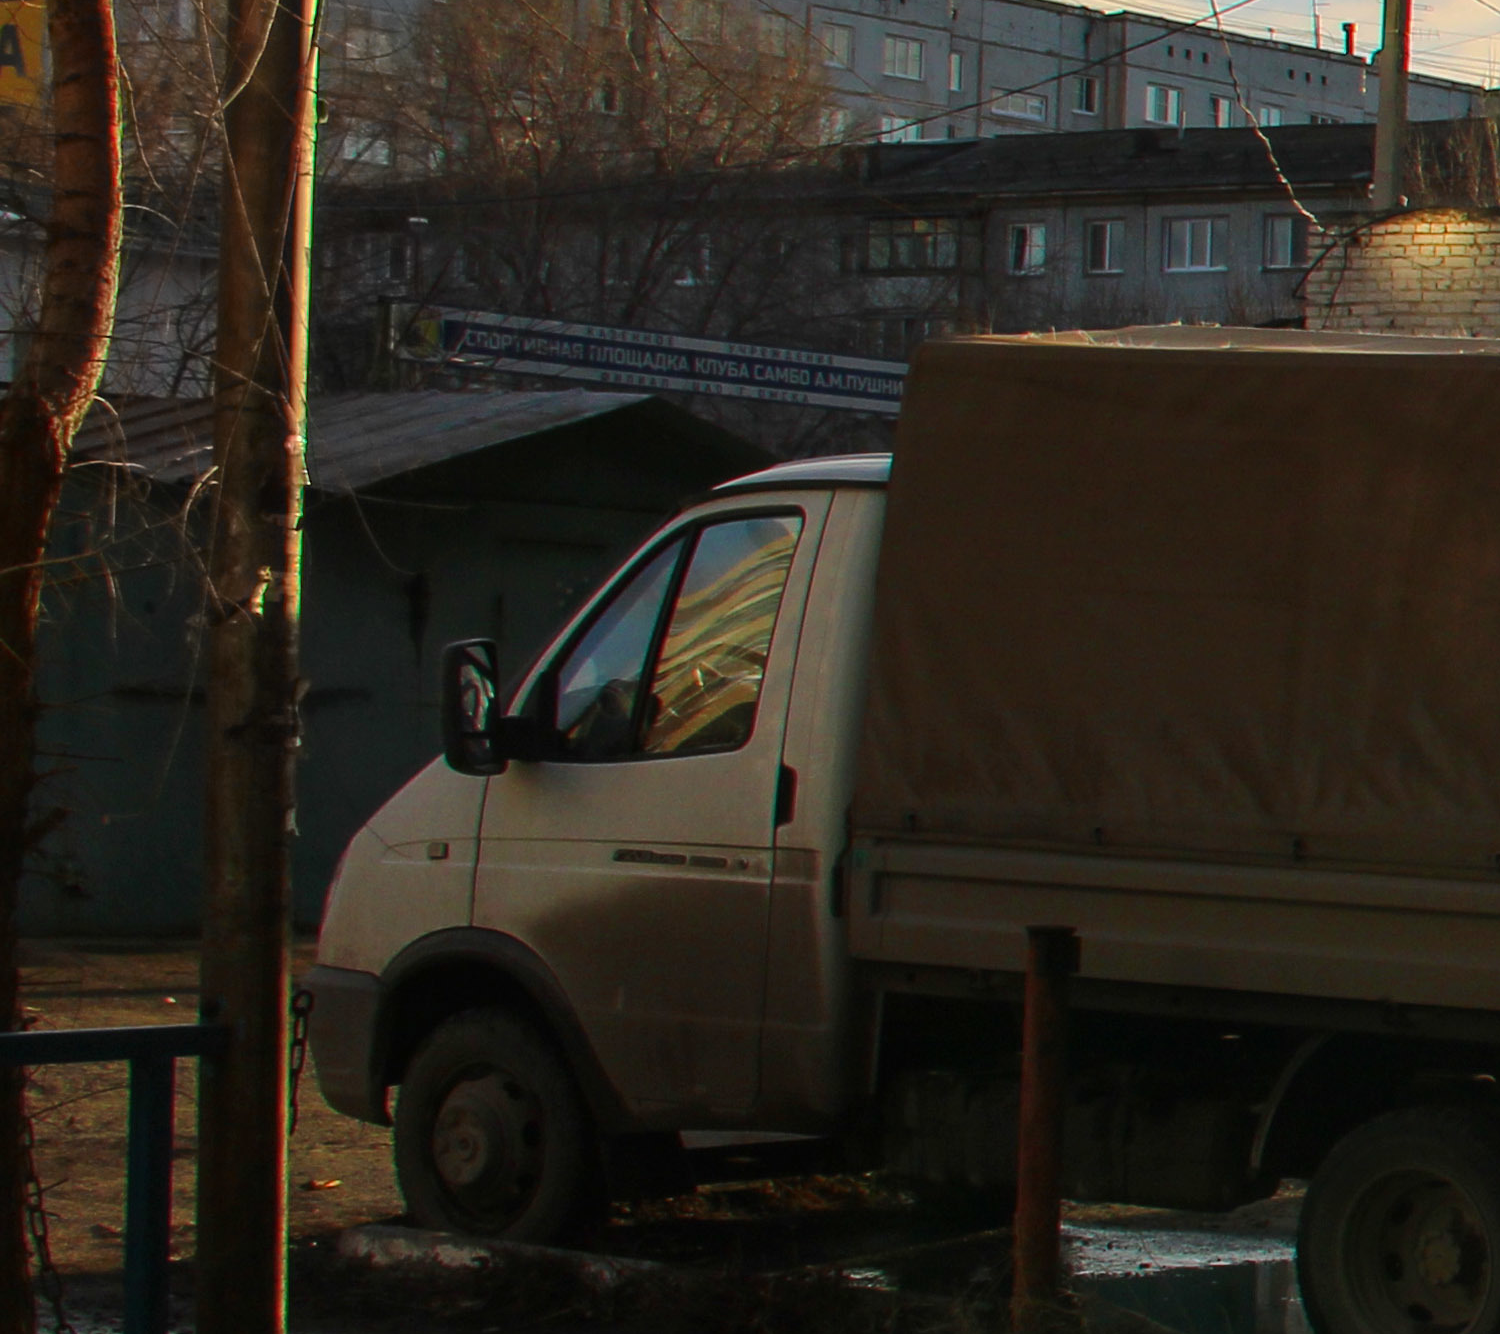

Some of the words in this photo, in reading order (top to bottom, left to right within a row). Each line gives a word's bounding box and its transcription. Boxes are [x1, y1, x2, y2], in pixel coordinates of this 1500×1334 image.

[465, 328, 586, 360] СПОРТИВНАЯ
[589, 345, 690, 372] ПЛОЩАДКА
[694, 357, 750, 379] КЛУБА
[753, 364, 811, 386] САМБО
